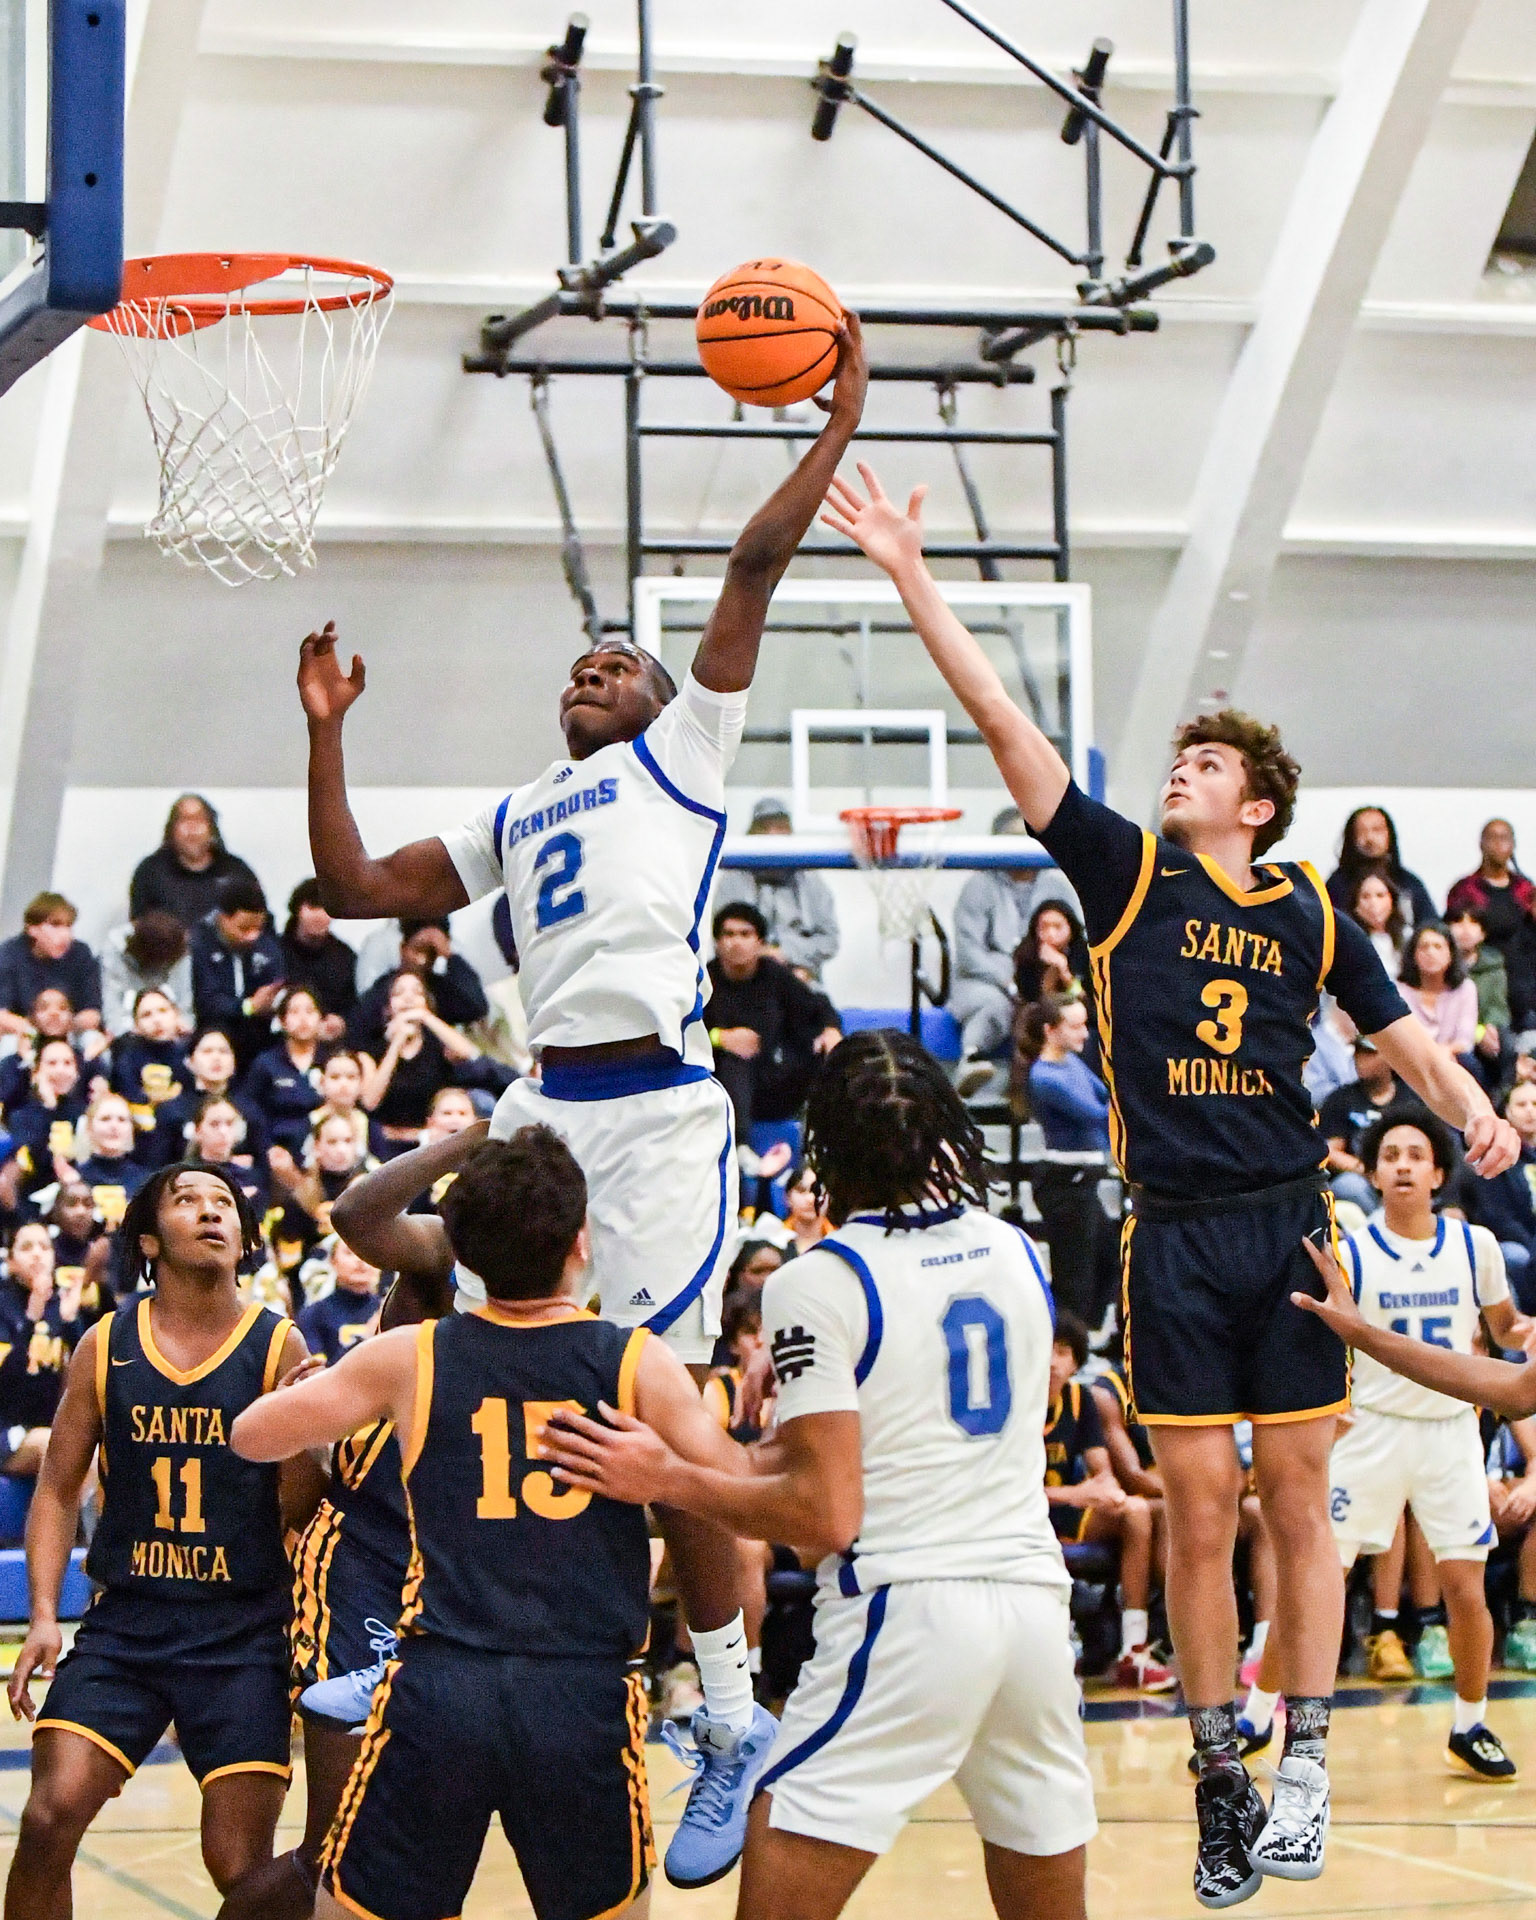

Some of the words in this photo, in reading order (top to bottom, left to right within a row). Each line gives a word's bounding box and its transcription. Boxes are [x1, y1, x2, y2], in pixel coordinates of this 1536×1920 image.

[704, 295, 795, 321] Wilson
[509, 778, 619, 848] CENTAURS
[534, 830, 587, 931] 2
[1181, 919, 1282, 976] SANTA
[1196, 979, 1249, 1055] 3
[968, 1247, 990, 1259] CITY
[1379, 1287, 1459, 1309] CENTAURS
[938, 1293, 1013, 1440] 0
[131, 1405, 227, 1445] SANTA
[471, 1397, 593, 1520] 15
[151, 1457, 205, 1532] 11
[130, 1541, 232, 1582] MONICA
